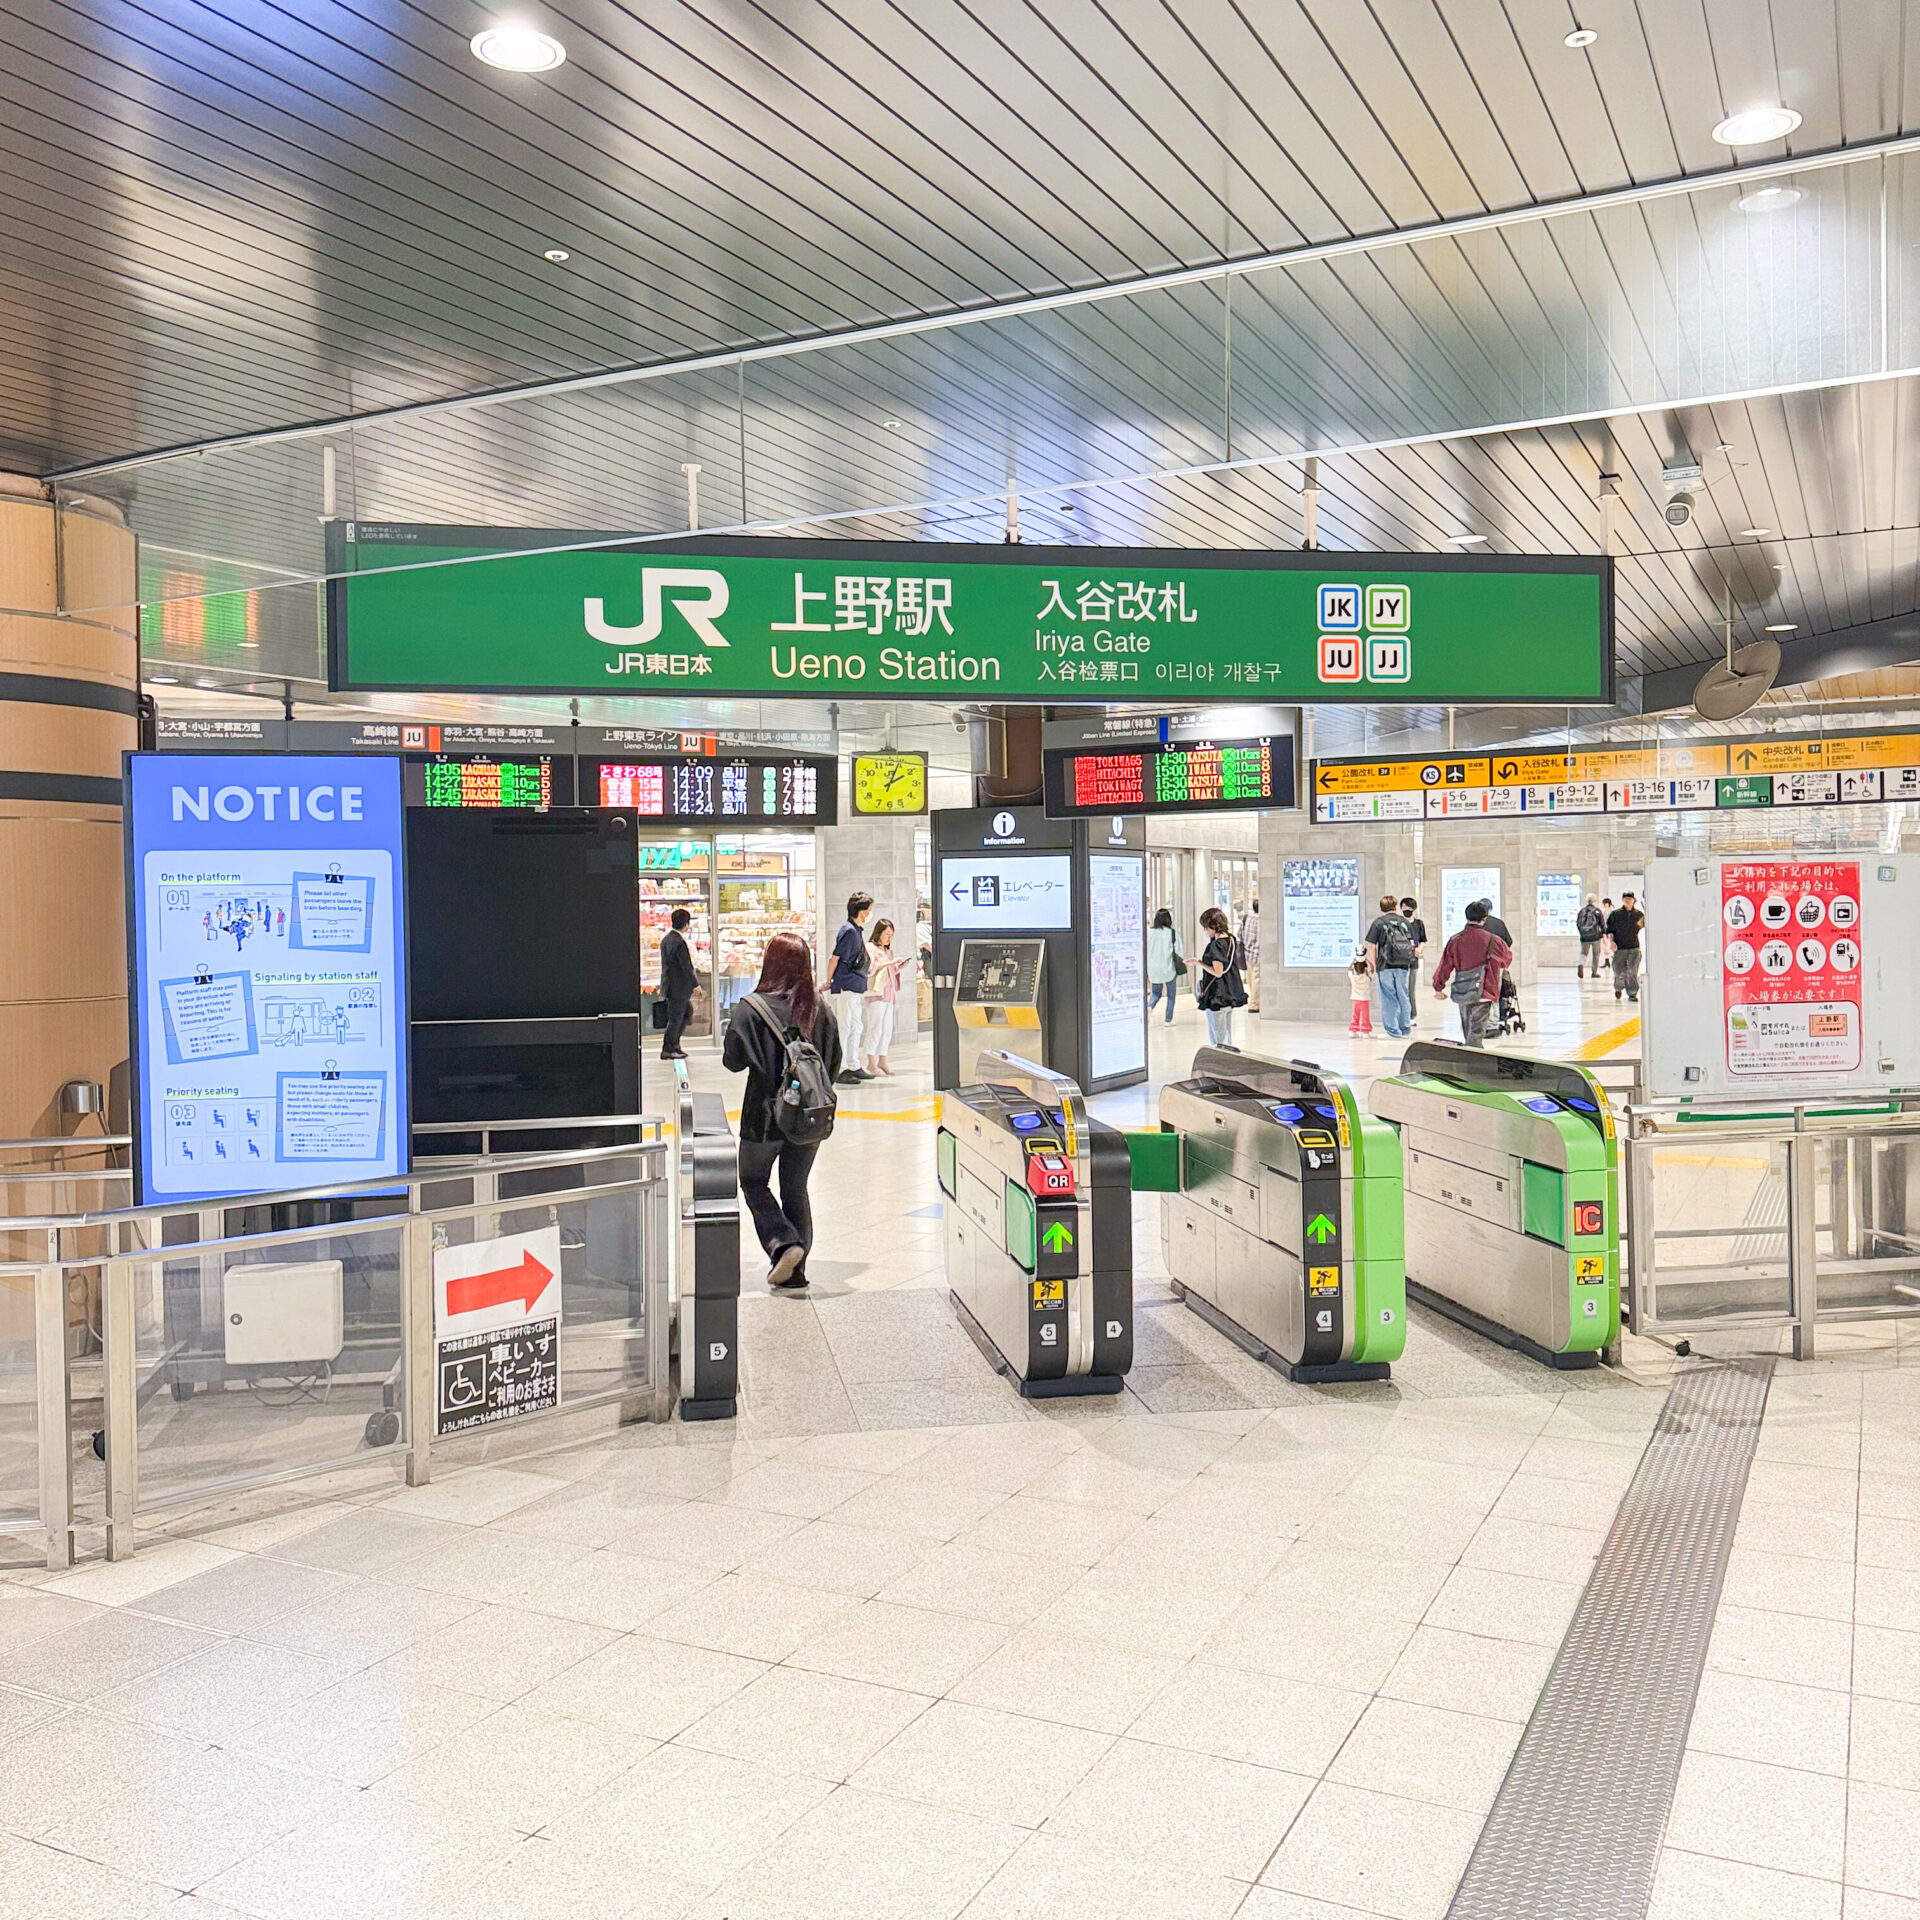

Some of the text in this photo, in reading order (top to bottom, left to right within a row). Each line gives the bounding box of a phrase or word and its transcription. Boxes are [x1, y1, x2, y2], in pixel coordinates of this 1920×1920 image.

[584, 567, 732, 647] JR
[771, 572, 955, 637] 上野駅
[1036, 580, 1198, 623] 入谷改札
[1327, 598, 1352, 618] JK
[1375, 598, 1400, 618] JY
[1035, 630, 1151, 657] Iriya Gate
[605, 652, 713, 676] JR東日本
[771, 645, 1001, 682] Ueno Station
[1327, 649, 1352, 669] JU
[1378, 649, 1398, 669] JJ
[1037, 660, 1139, 682] 入谷检票口
[1155, 662, 1283, 683] 이리야 개찰구
[362, 725, 399, 737] 高崎線
[406, 731, 421, 742] JU
[602, 729, 678, 742] 上野東京ライン
[350, 737, 400, 746] Takasaki Line
[684, 736, 698, 747] JU
[1155, 752, 1187, 765] 14:30
[1261, 746, 1271, 759] 8
[1763, 745, 1804, 756] 中央改札
[424, 763, 551, 776] 14:05 5
[1155, 764, 1188, 777] 15:00
[1261, 759, 1271, 772] 8
[1522, 758, 1560, 769] 入谷改札
[600, 765, 663, 778] ときわ68号
[673, 765, 713, 779] 14:09
[722, 767, 747, 779] 品川
[1342, 768, 1375, 778] 公園改札
[1426, 770, 1436, 780] KS
[424, 776, 461, 788] 14:27
[541, 777, 551, 788] 5
[673, 778, 712, 790] 14:11
[1156, 777, 1188, 789] 15:30
[1261, 771, 1271, 784] 8
[424, 788, 461, 800] 14:45
[541, 789, 551, 800] 5
[673, 790, 712, 802] 14:21
[907, 791, 913, 799] 4
[1156, 789, 1188, 802] 16:00
[1261, 784, 1272, 797] 8
[1528, 787, 1536, 798] 8
[1736, 790, 1757, 798] 新幹線
[172, 785, 363, 822] NOTICE
[673, 802, 714, 815] 14:24
[722, 802, 747, 815] 品川
[983, 836, 1026, 846] Information
[161, 872, 241, 883] On the platform
[1292, 868, 1351, 879] CRAFTERS
[1002, 880, 1065, 892] エレベーター
[1292, 878, 1352, 888] MARKET
[166, 889, 190, 905] 01
[1002, 894, 1030, 902] Elevator
[254, 970, 378, 983] Signaling by station staff
[348, 987, 375, 1002] 02
[1818, 1015, 1840, 1023] 上野駅
[166, 1086, 239, 1097] Priority seating
[170, 1104, 196, 1120] 03
[1048, 1175, 1069, 1187] QR
[1574, 1205, 1601, 1233] IC
[1587, 1302, 1594, 1312] 3
[1321, 1313, 1328, 1323] 4
[1383, 1311, 1391, 1321] 3
[1045, 1326, 1053, 1337] 5
[1110, 1324, 1117, 1334] 4
[488, 1333, 556, 1365] 車いす
[714, 1346, 721, 1357] 5
[488, 1357, 556, 1384] ベビーカー
[488, 1374, 556, 1408] ご利用のお客さま
